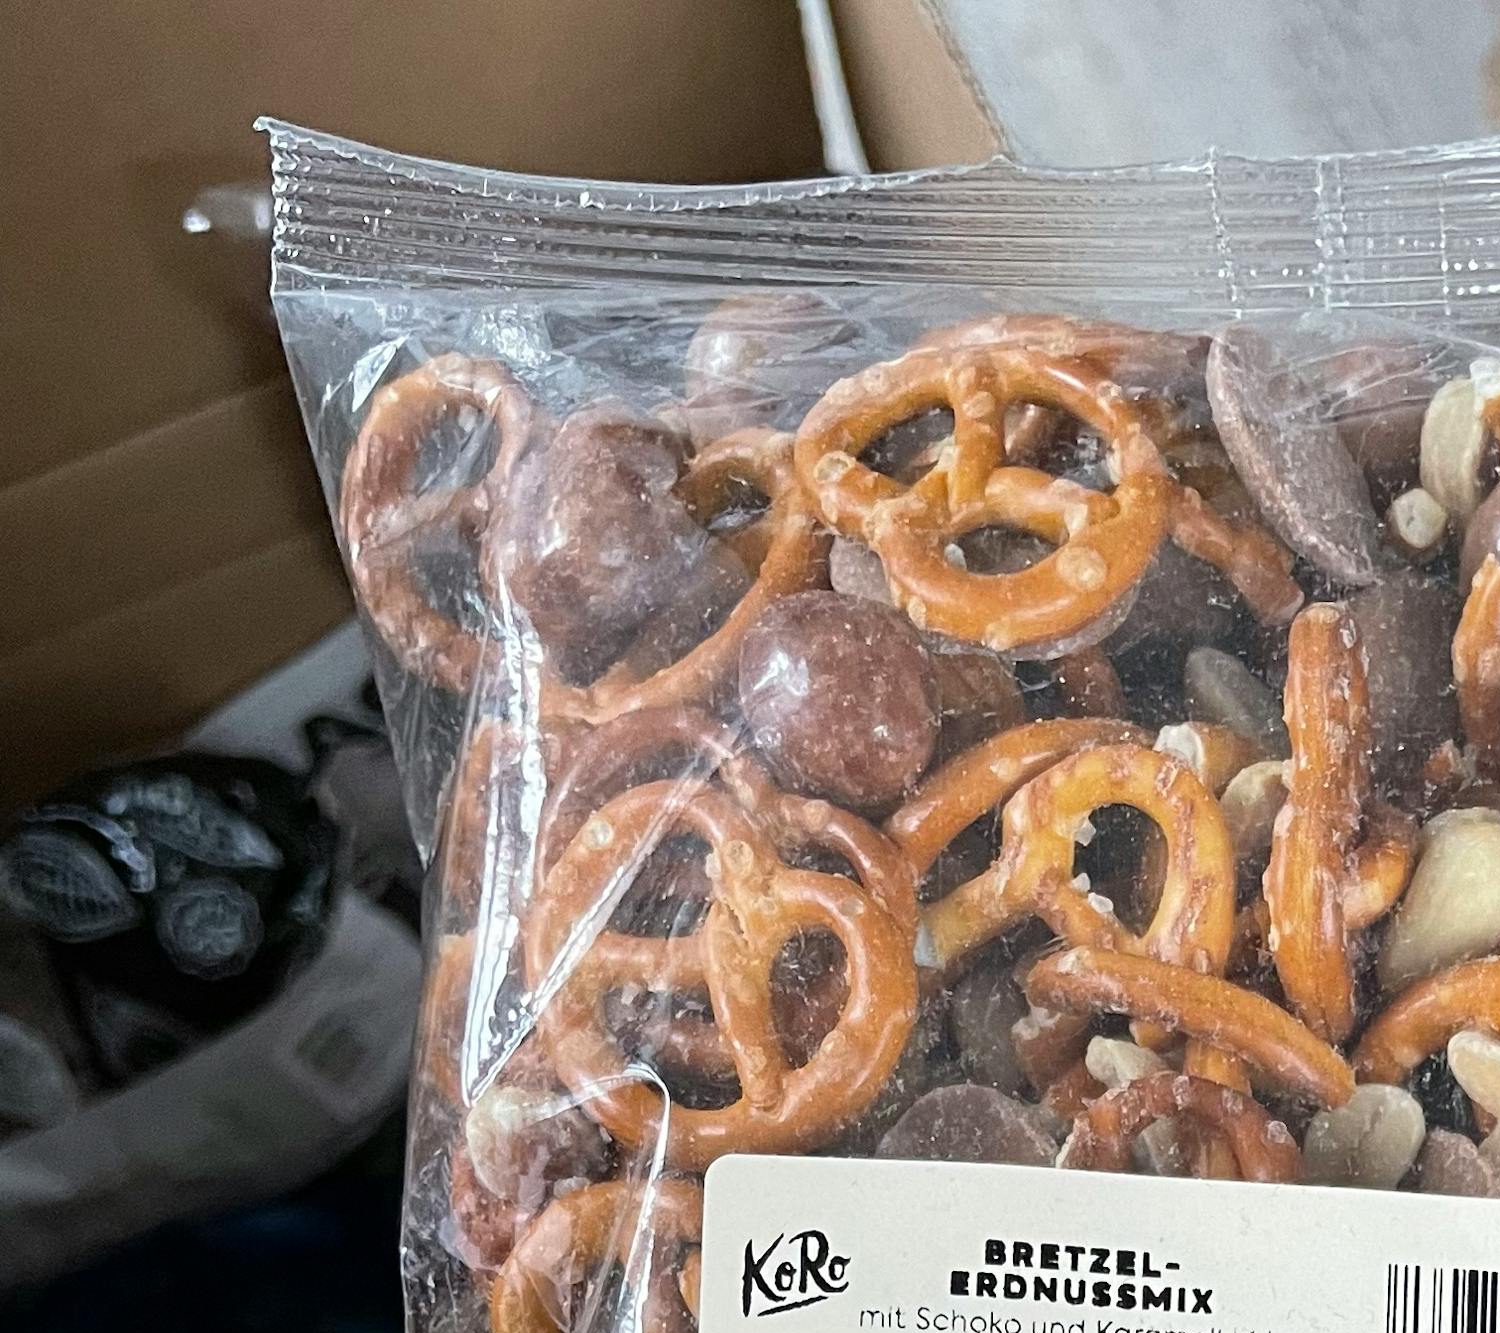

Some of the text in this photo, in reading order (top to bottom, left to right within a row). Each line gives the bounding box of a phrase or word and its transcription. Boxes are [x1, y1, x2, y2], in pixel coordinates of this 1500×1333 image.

[743, 1230, 852, 1318] KoRo
[984, 1239, 1180, 1278] BRETZEL-
[949, 1270, 1212, 1314] ERDNUSSMIX
[859, 1305, 906, 1328] mit
